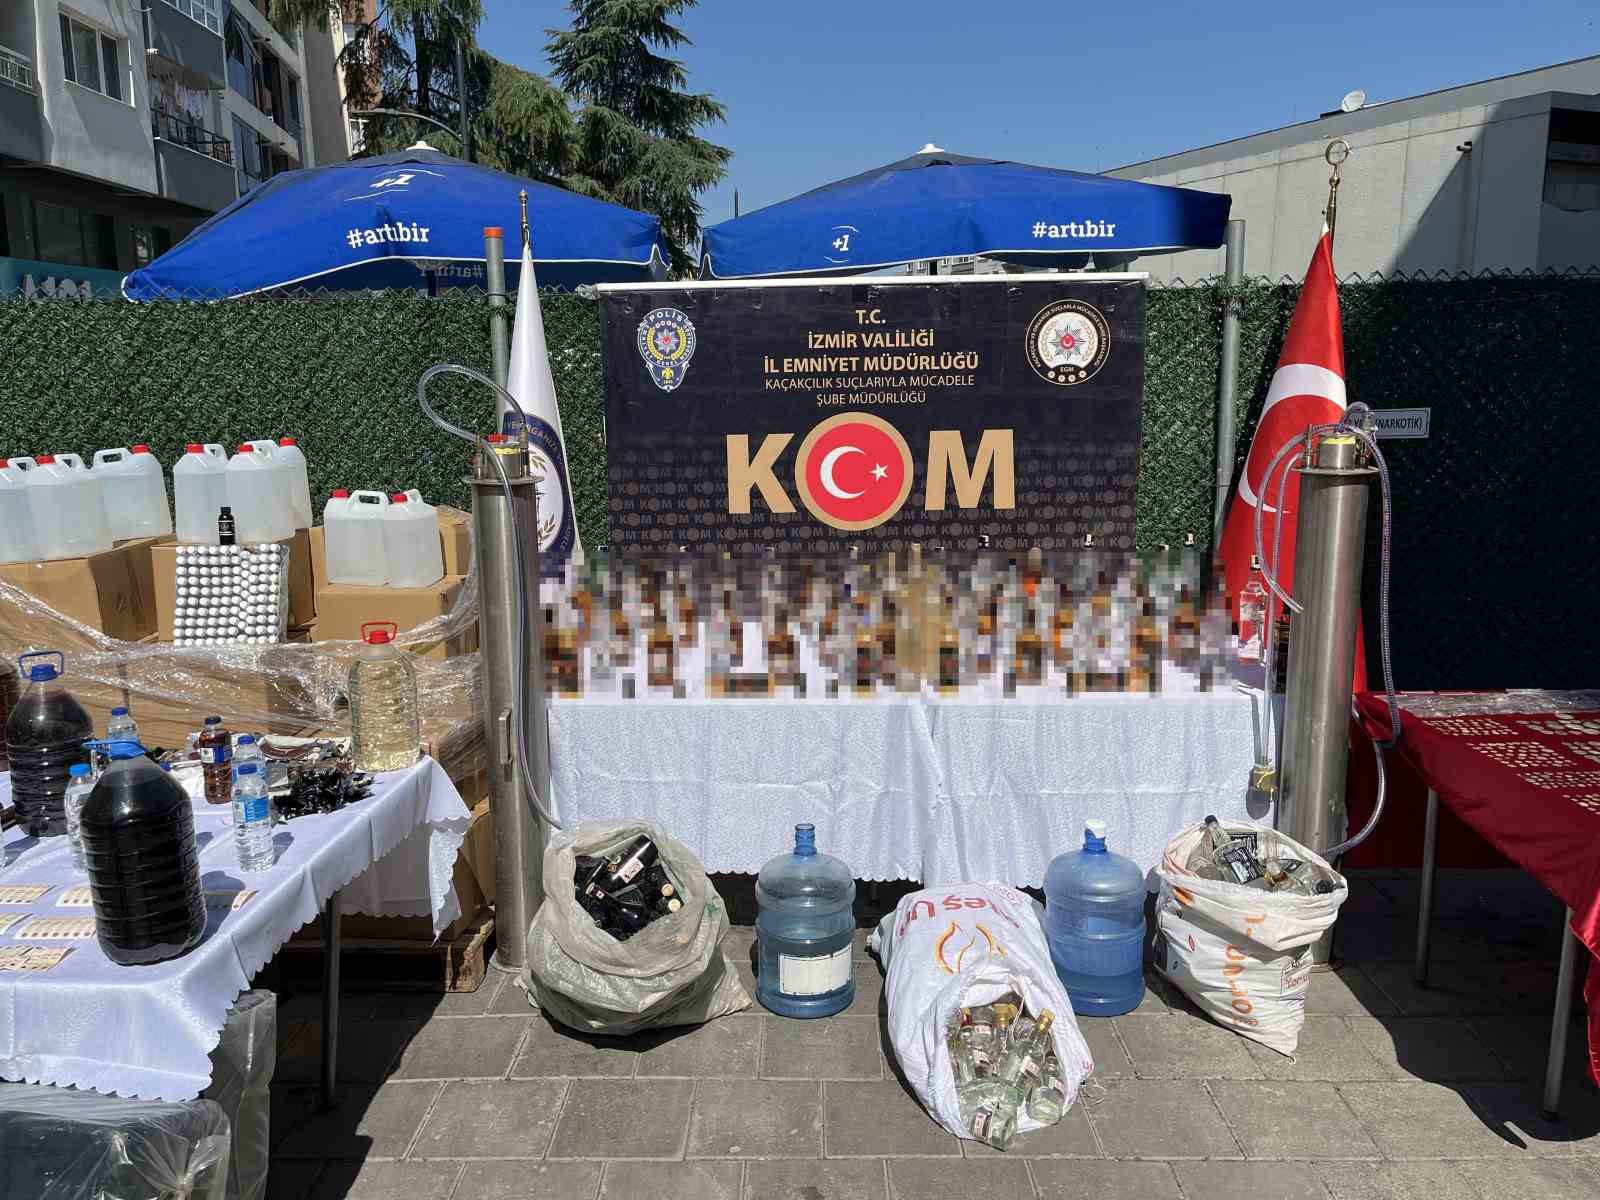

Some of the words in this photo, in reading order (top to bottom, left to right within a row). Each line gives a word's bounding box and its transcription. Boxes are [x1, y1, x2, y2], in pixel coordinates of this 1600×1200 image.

[346, 222, 430, 249] #artıbir
[1032, 219, 1116, 238] #artıbir
[832, 234, 850, 252] +1
[855, 309, 886, 325] T.C.
[808, 331, 857, 350] İZMİR
[862, 328, 934, 348] VALİLİĞİ
[764, 355, 780, 374] İL
[783, 354, 860, 373] EMNİYET
[863, 351, 979, 371] MÜDÜRLÜĞÜ
[765, 377, 834, 392] KAÇAKÇILIK
[835, 376, 907, 390] SUÇLARIYLA
[909, 374, 976, 387] MÜCADELE
[816, 393, 846, 408] ŞUBE
[848, 390, 927, 405] MÜDÜRLÜĞÜ
[727, 412, 1015, 531] KOM
[608, 497, 634, 512] OM
[610, 528, 636, 543] OM
